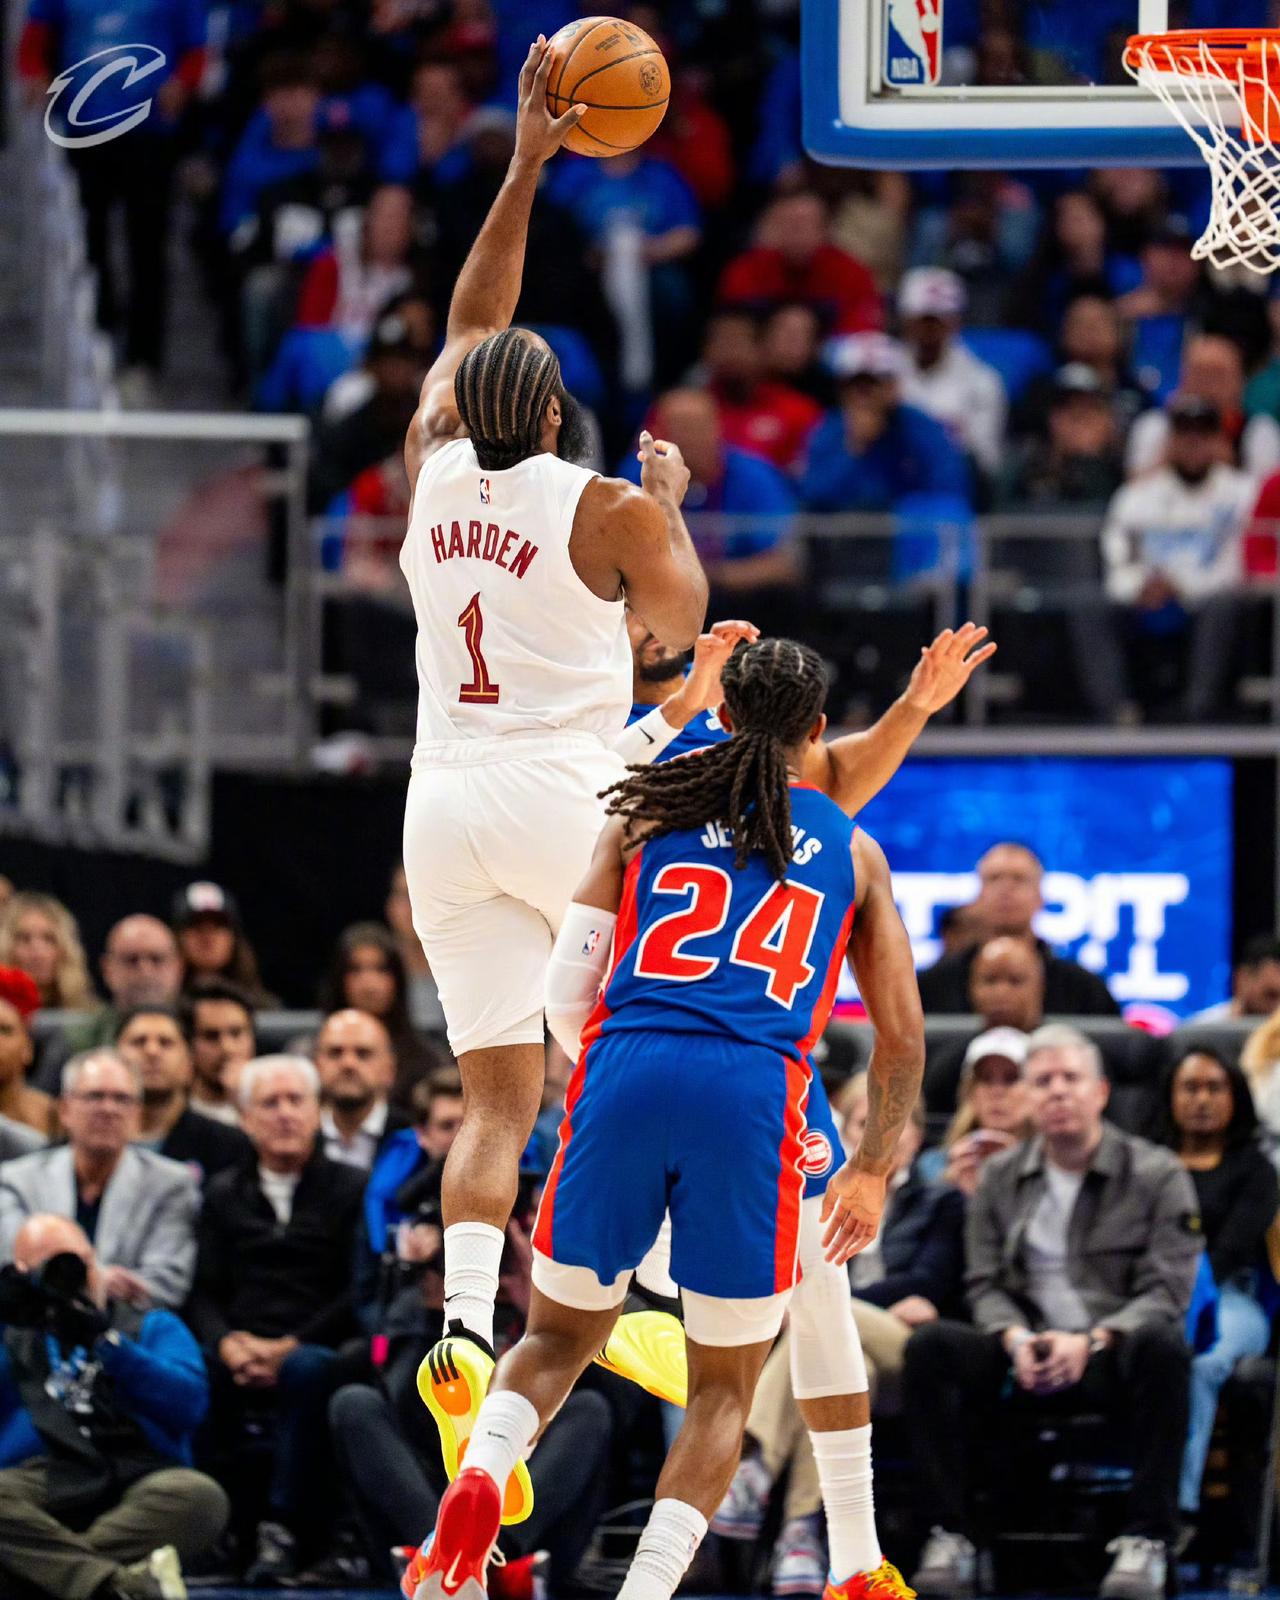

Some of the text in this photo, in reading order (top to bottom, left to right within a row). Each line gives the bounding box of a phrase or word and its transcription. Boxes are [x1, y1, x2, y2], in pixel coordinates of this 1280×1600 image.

[891, 57, 919, 79] NBA
[430, 520, 539, 579] HARDEN
[458, 591, 499, 704] 1
[633, 862, 825, 1011] 24
